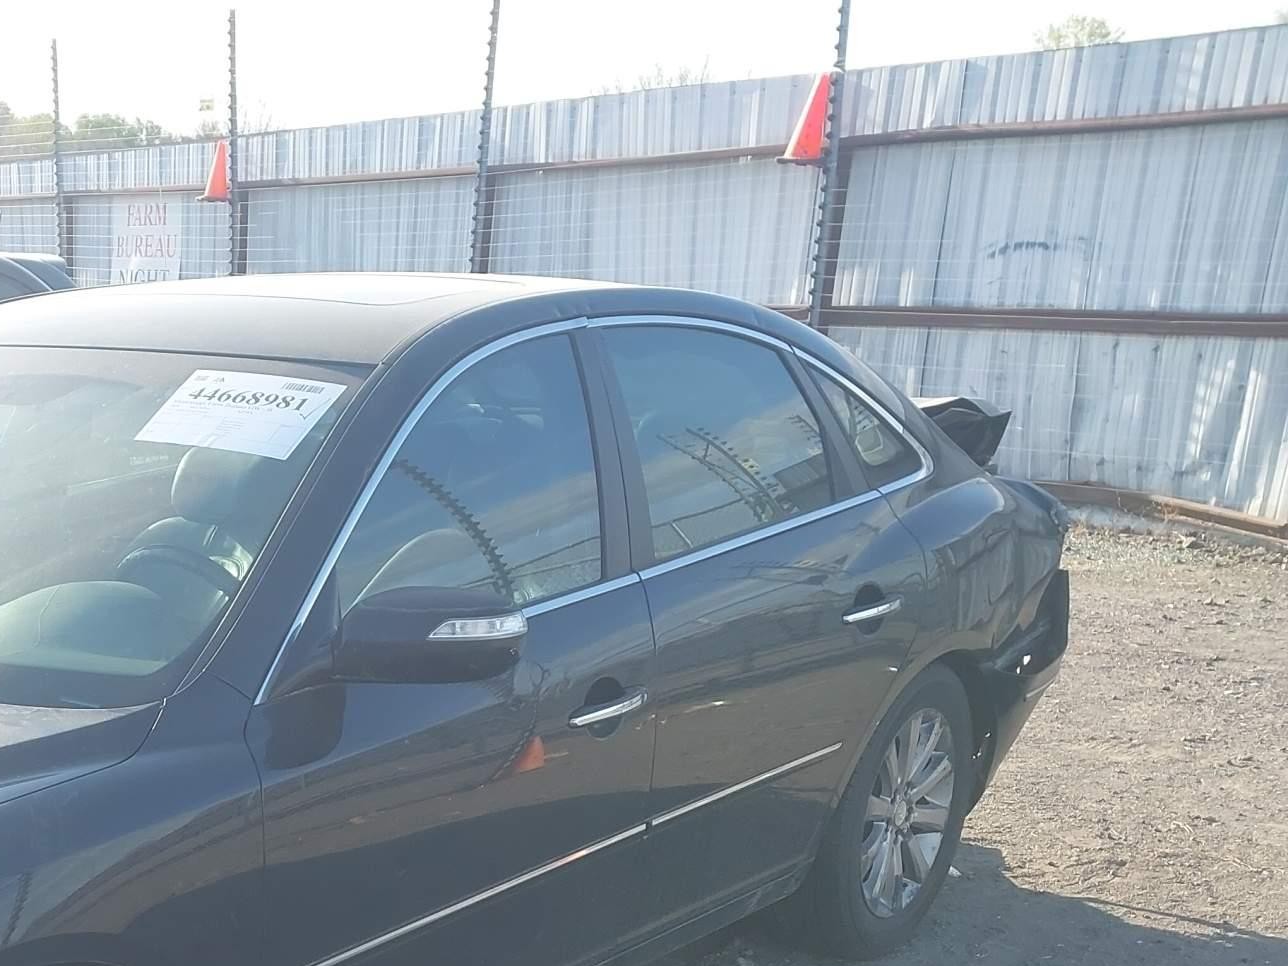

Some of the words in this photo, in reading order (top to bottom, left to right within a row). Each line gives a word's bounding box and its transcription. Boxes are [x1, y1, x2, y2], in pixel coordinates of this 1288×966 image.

[127, 202, 168, 226] FARM
[116, 234, 177, 258] BUREAU
[188, 387, 309, 411] 44668981
